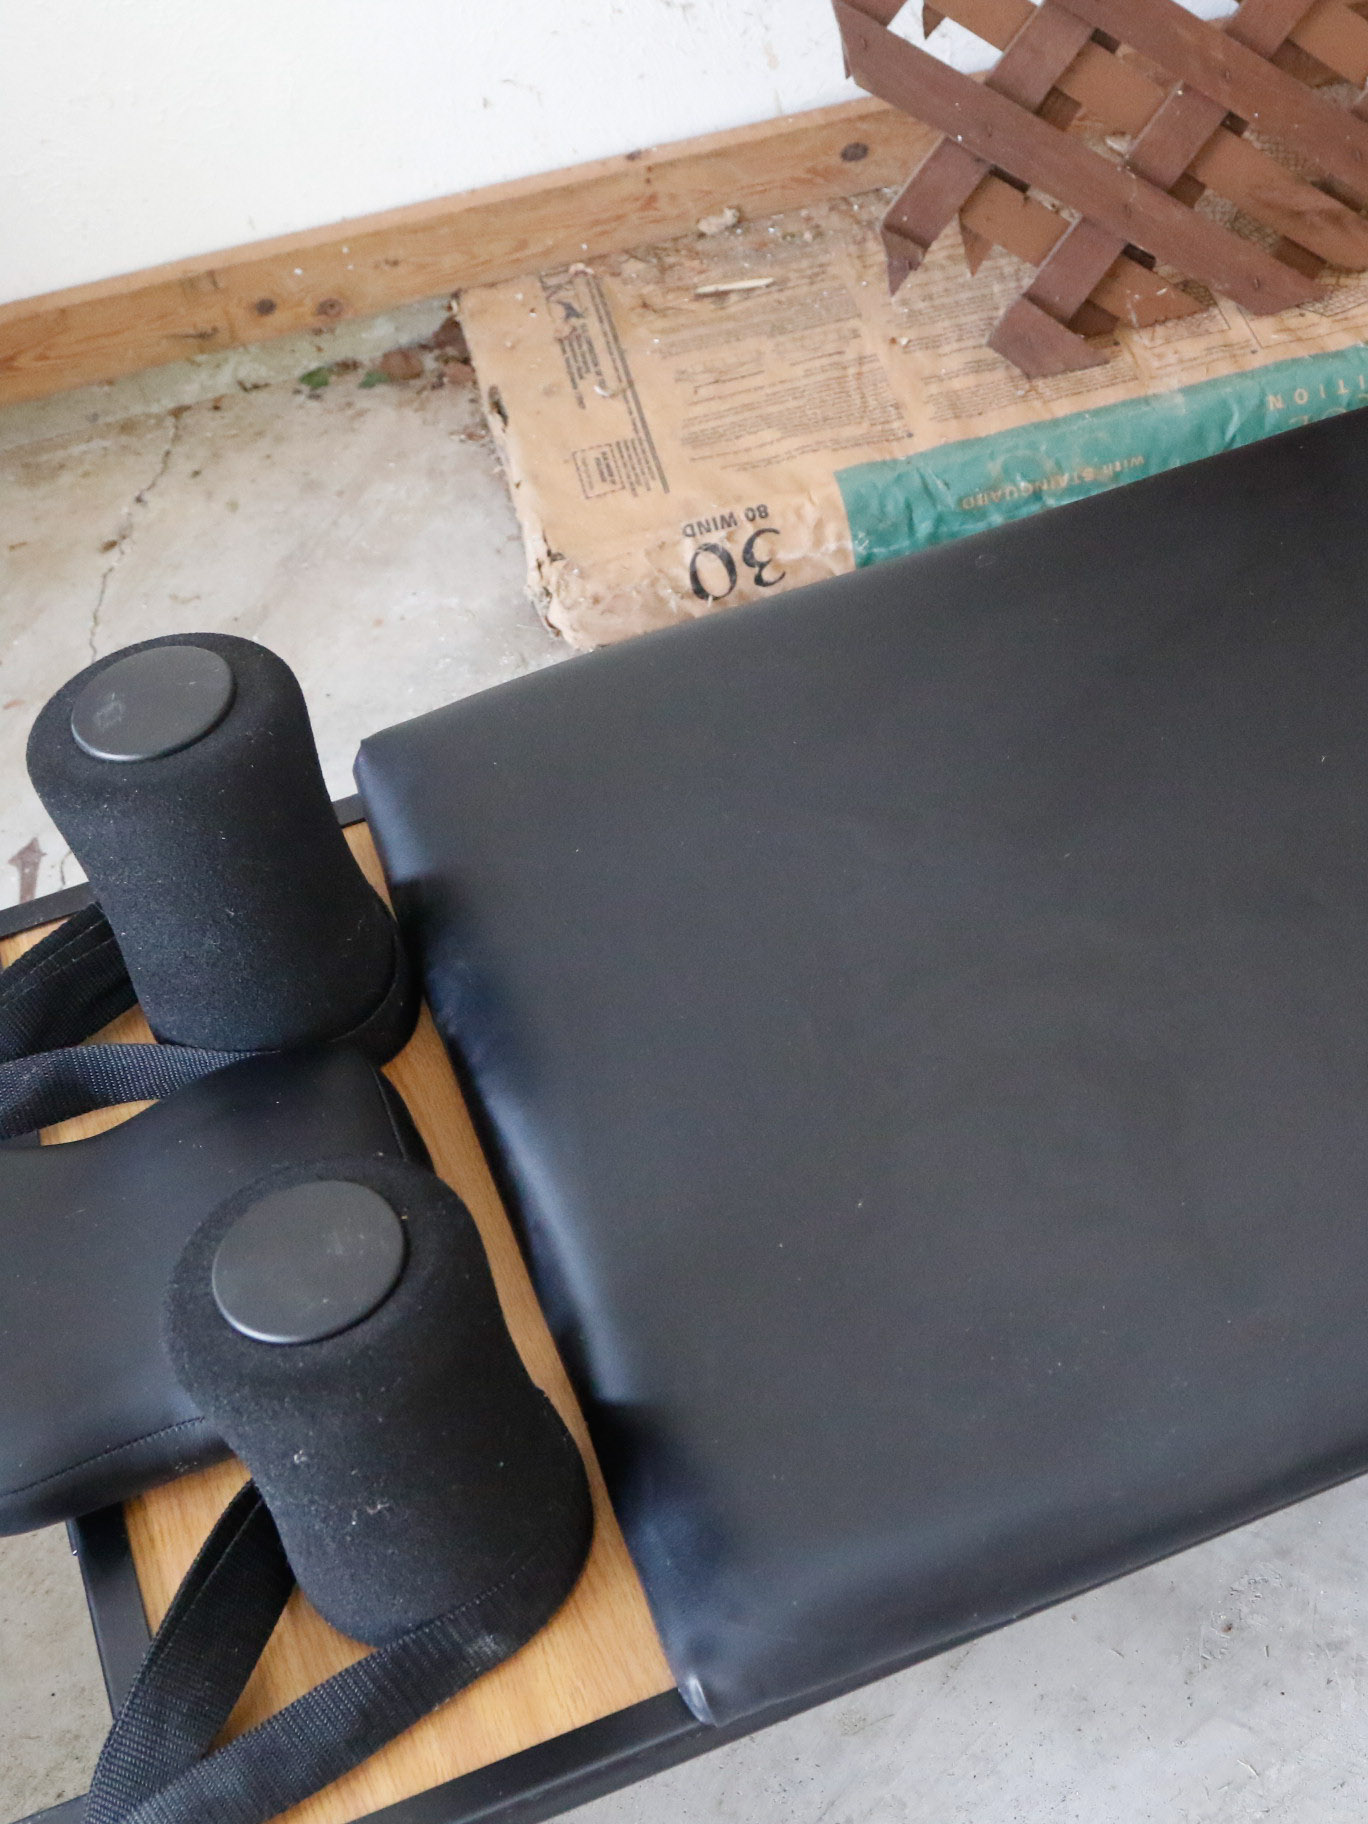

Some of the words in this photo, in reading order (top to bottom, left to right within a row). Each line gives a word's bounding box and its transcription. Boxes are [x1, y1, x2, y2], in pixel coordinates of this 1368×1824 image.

[1102, 455, 1146, 476] with
[682, 511, 738, 538] WIND
[744, 503, 769, 522] 80
[689, 527, 786, 601] 30
